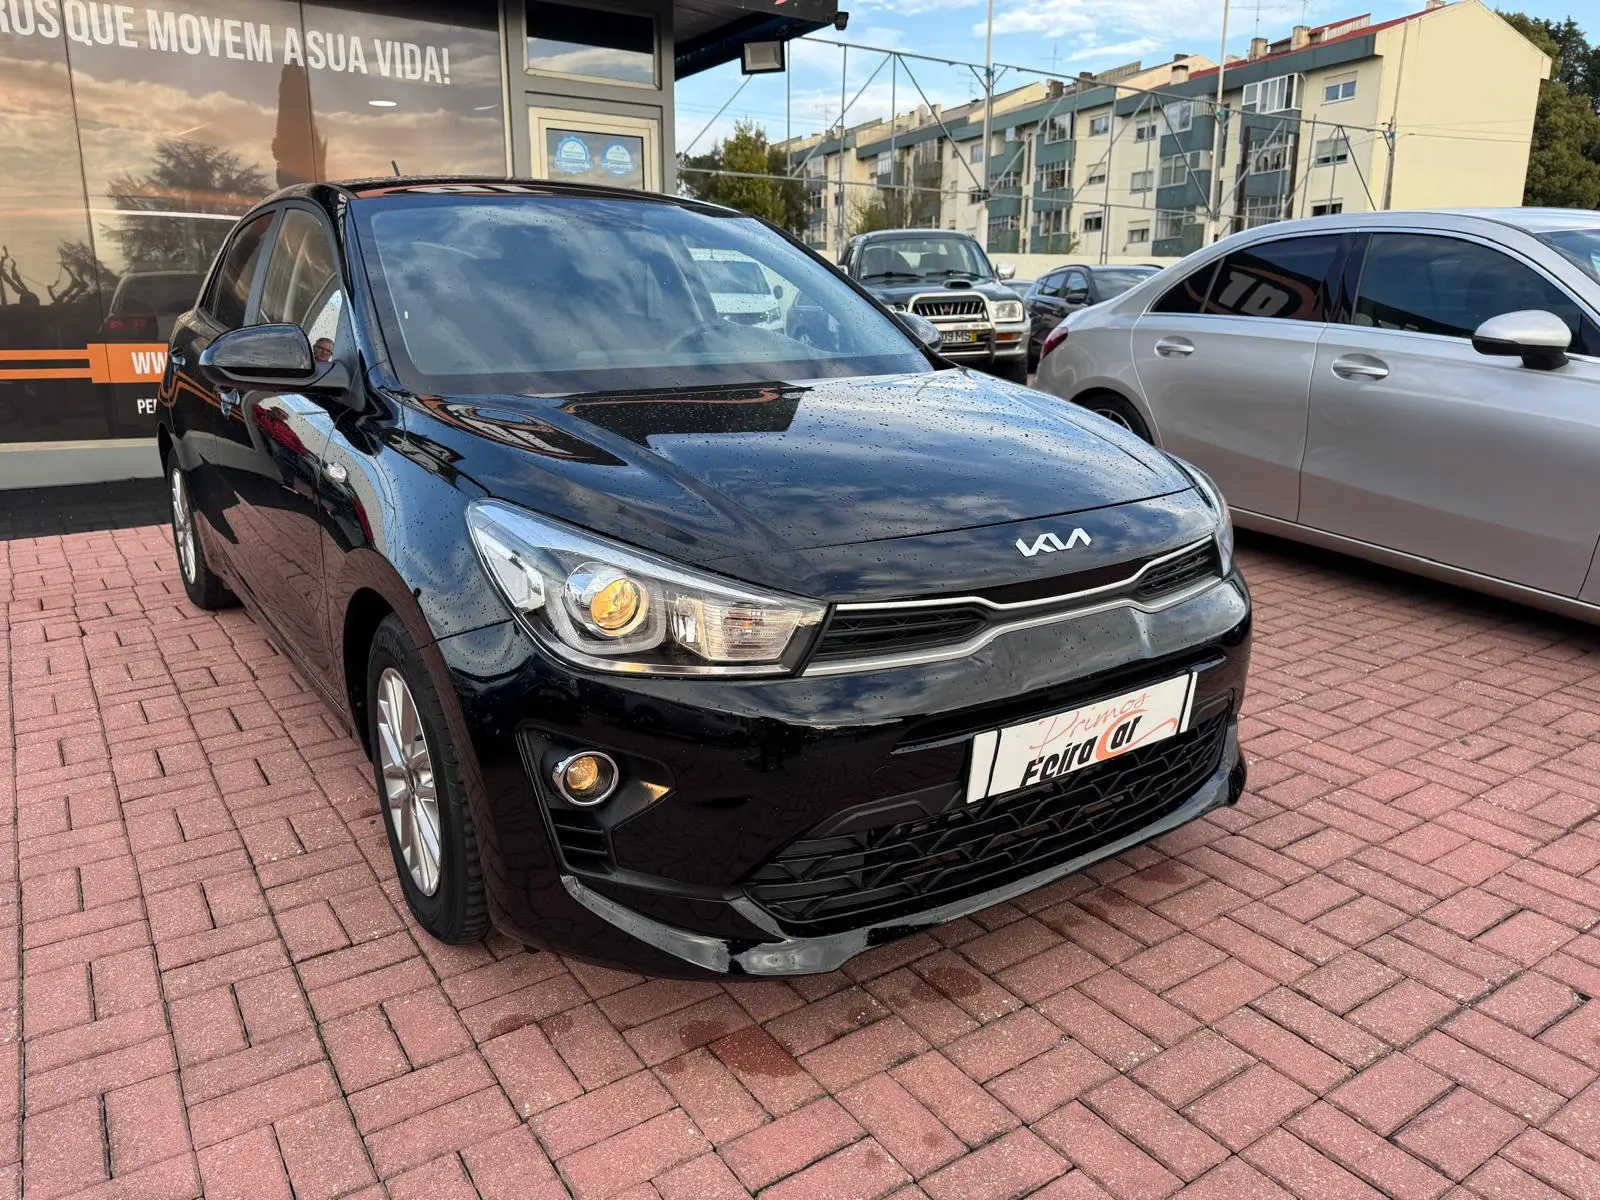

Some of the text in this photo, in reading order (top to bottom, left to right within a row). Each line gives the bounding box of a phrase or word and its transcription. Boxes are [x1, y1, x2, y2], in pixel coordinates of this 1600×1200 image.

[64, 0, 138, 48] QUE
[147, 9, 273, 63] MOVEM
[284, 27, 303, 66] A
[307, 30, 367, 74] SUA
[374, 38, 451, 84] VIDA!
[1015, 527, 1092, 557] KIA
